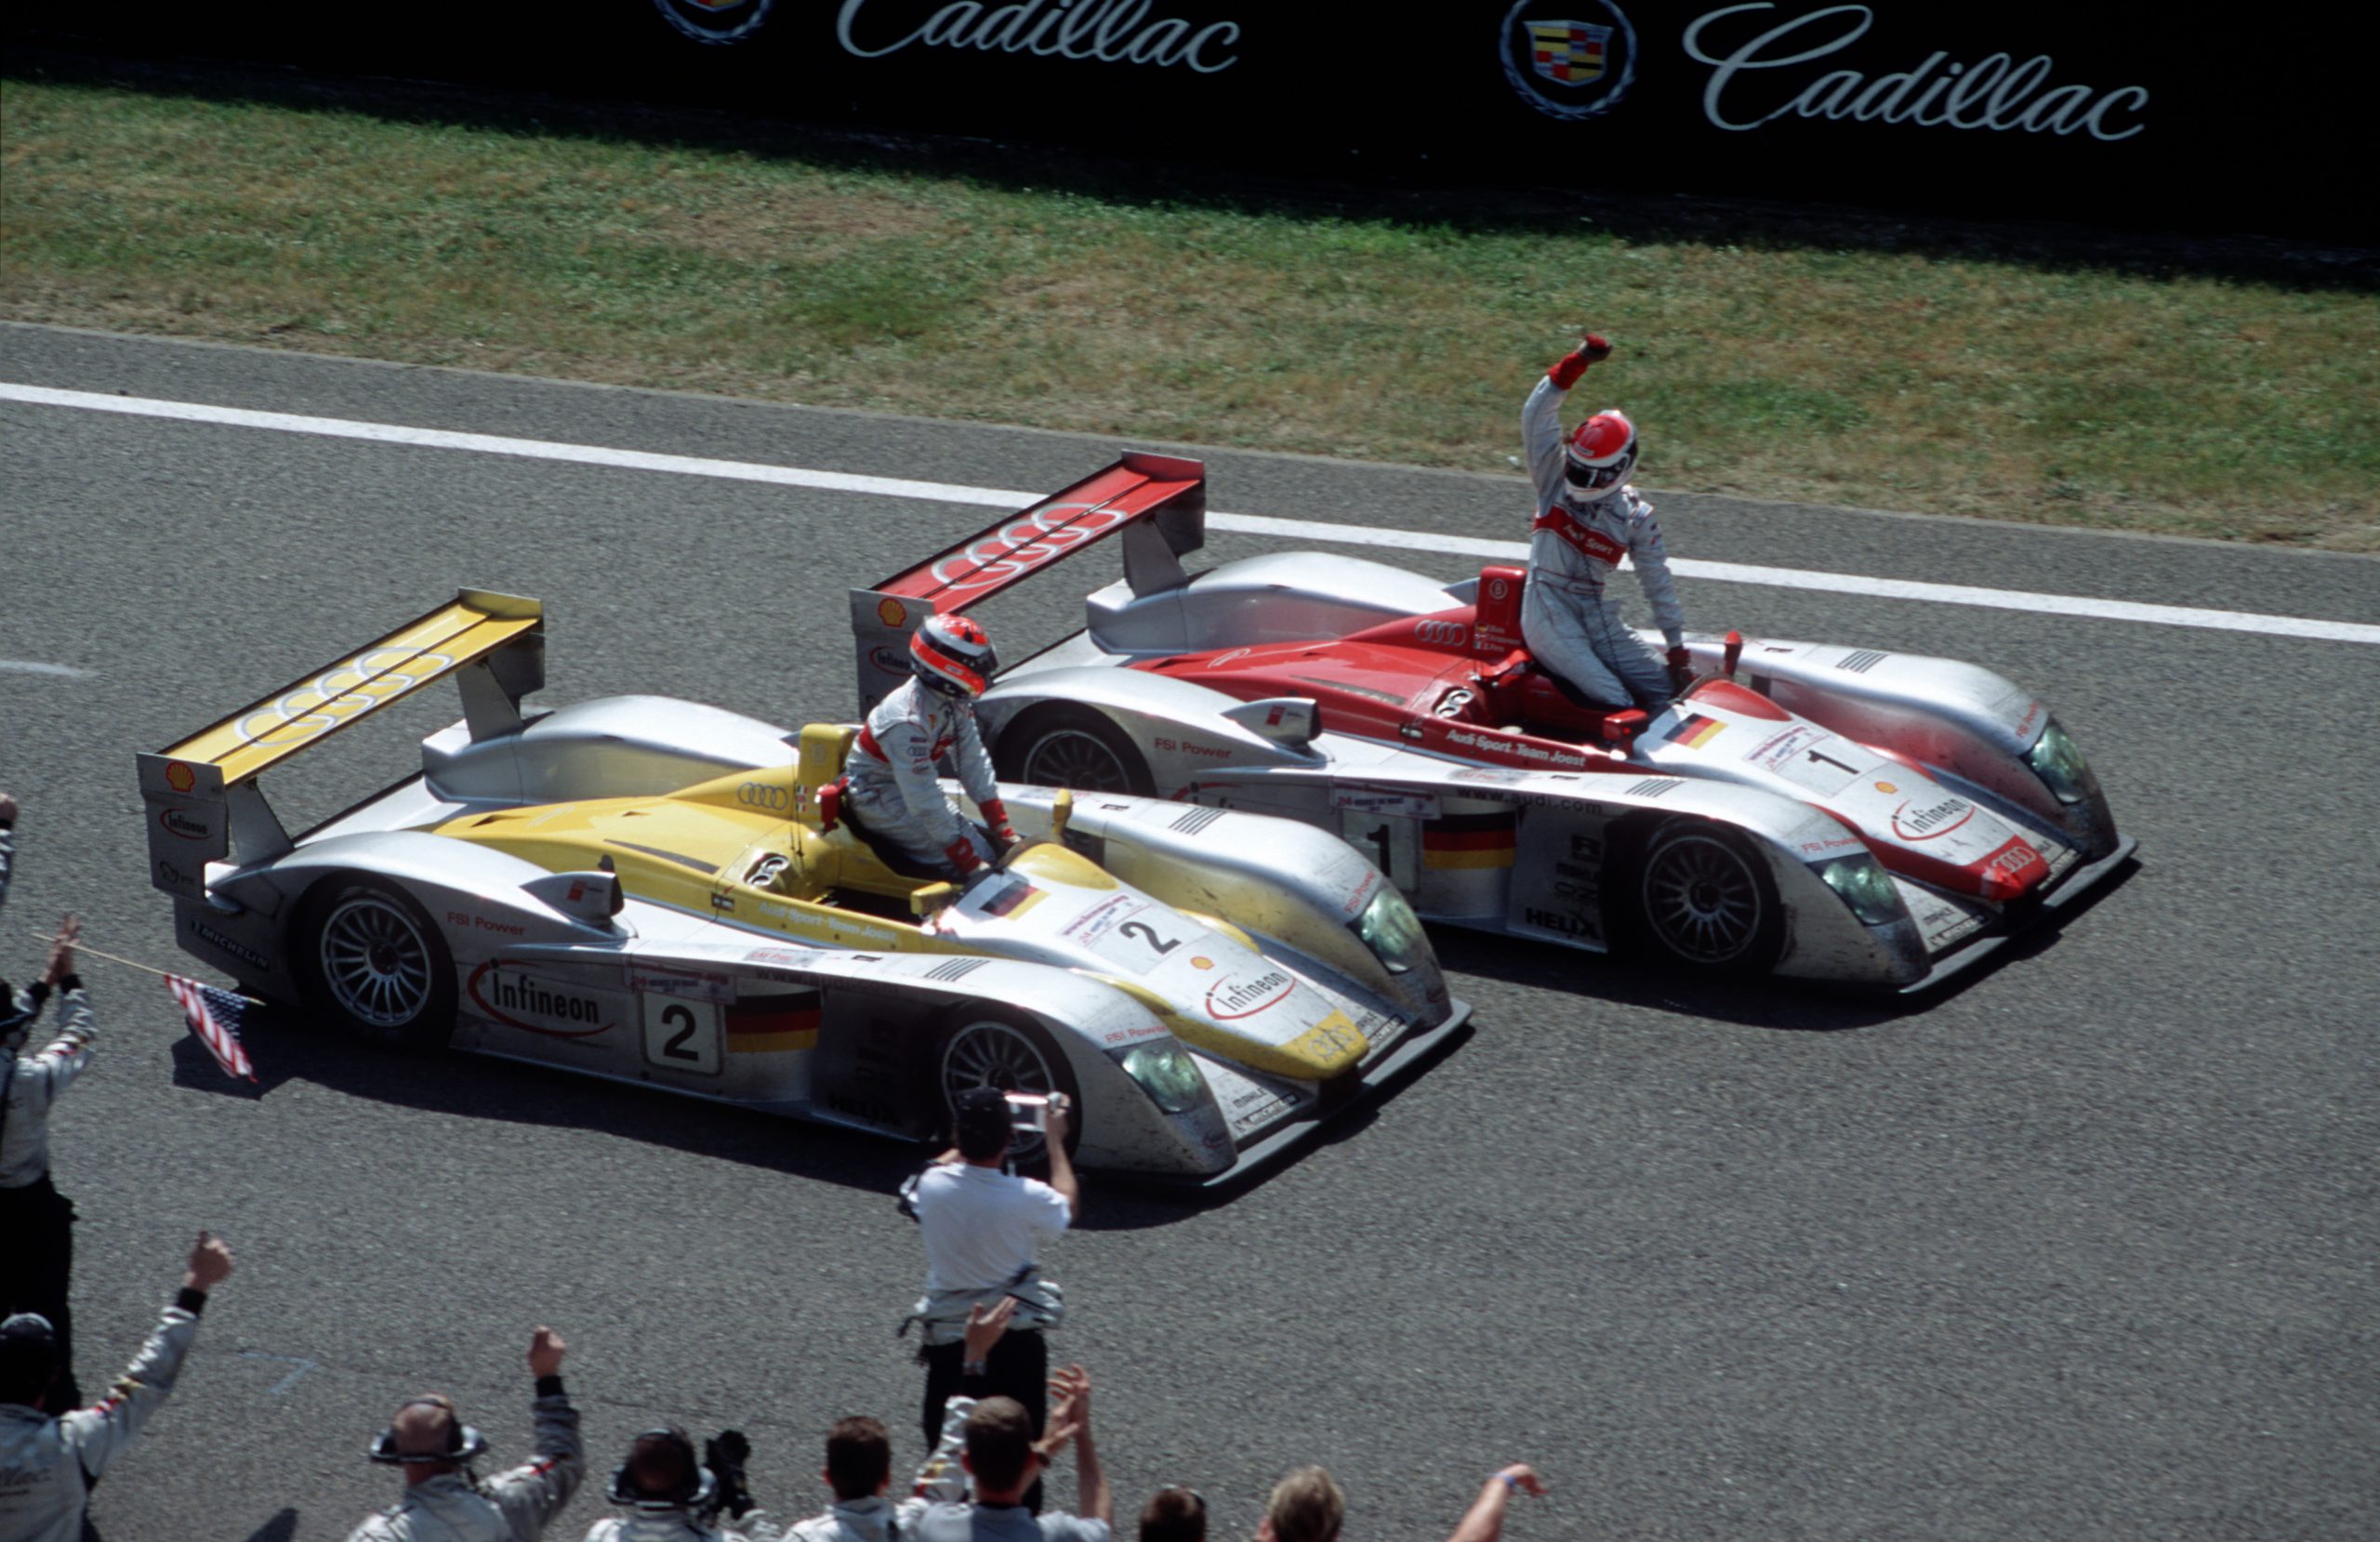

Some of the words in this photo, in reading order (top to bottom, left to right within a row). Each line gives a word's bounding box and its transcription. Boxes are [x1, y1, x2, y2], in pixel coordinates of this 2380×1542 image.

[1682, 3, 2149, 140] Cadillac
[1154, 737, 1176, 752] FSI
[1181, 742, 1233, 759] Power
[1446, 730, 1475, 745] Audi
[1475, 735, 1511, 754] Sport
[1515, 743, 1549, 760] Team
[1550, 749, 1586, 767] Joest
[1807, 749, 1859, 775] 1
[1456, 785, 1603, 815] www.audi.com
[1902, 797, 1968, 833] Infineon
[1366, 824, 1391, 877] 1
[446, 912, 471, 929] FSI
[474, 916, 526, 937] Power
[788, 907, 823, 925] Sport
[201, 927, 269, 970] MICHELIN
[1119, 921, 1182, 956] 2
[491, 971, 599, 1023] Infineon
[1216, 970, 1288, 1012] Infineon
[662, 1004, 700, 1061] 2
[1104, 1031, 1123, 1044] FSI
[1126, 1023, 1167, 1040] Power
[1233, 1087, 1267, 1109] MAHLE
